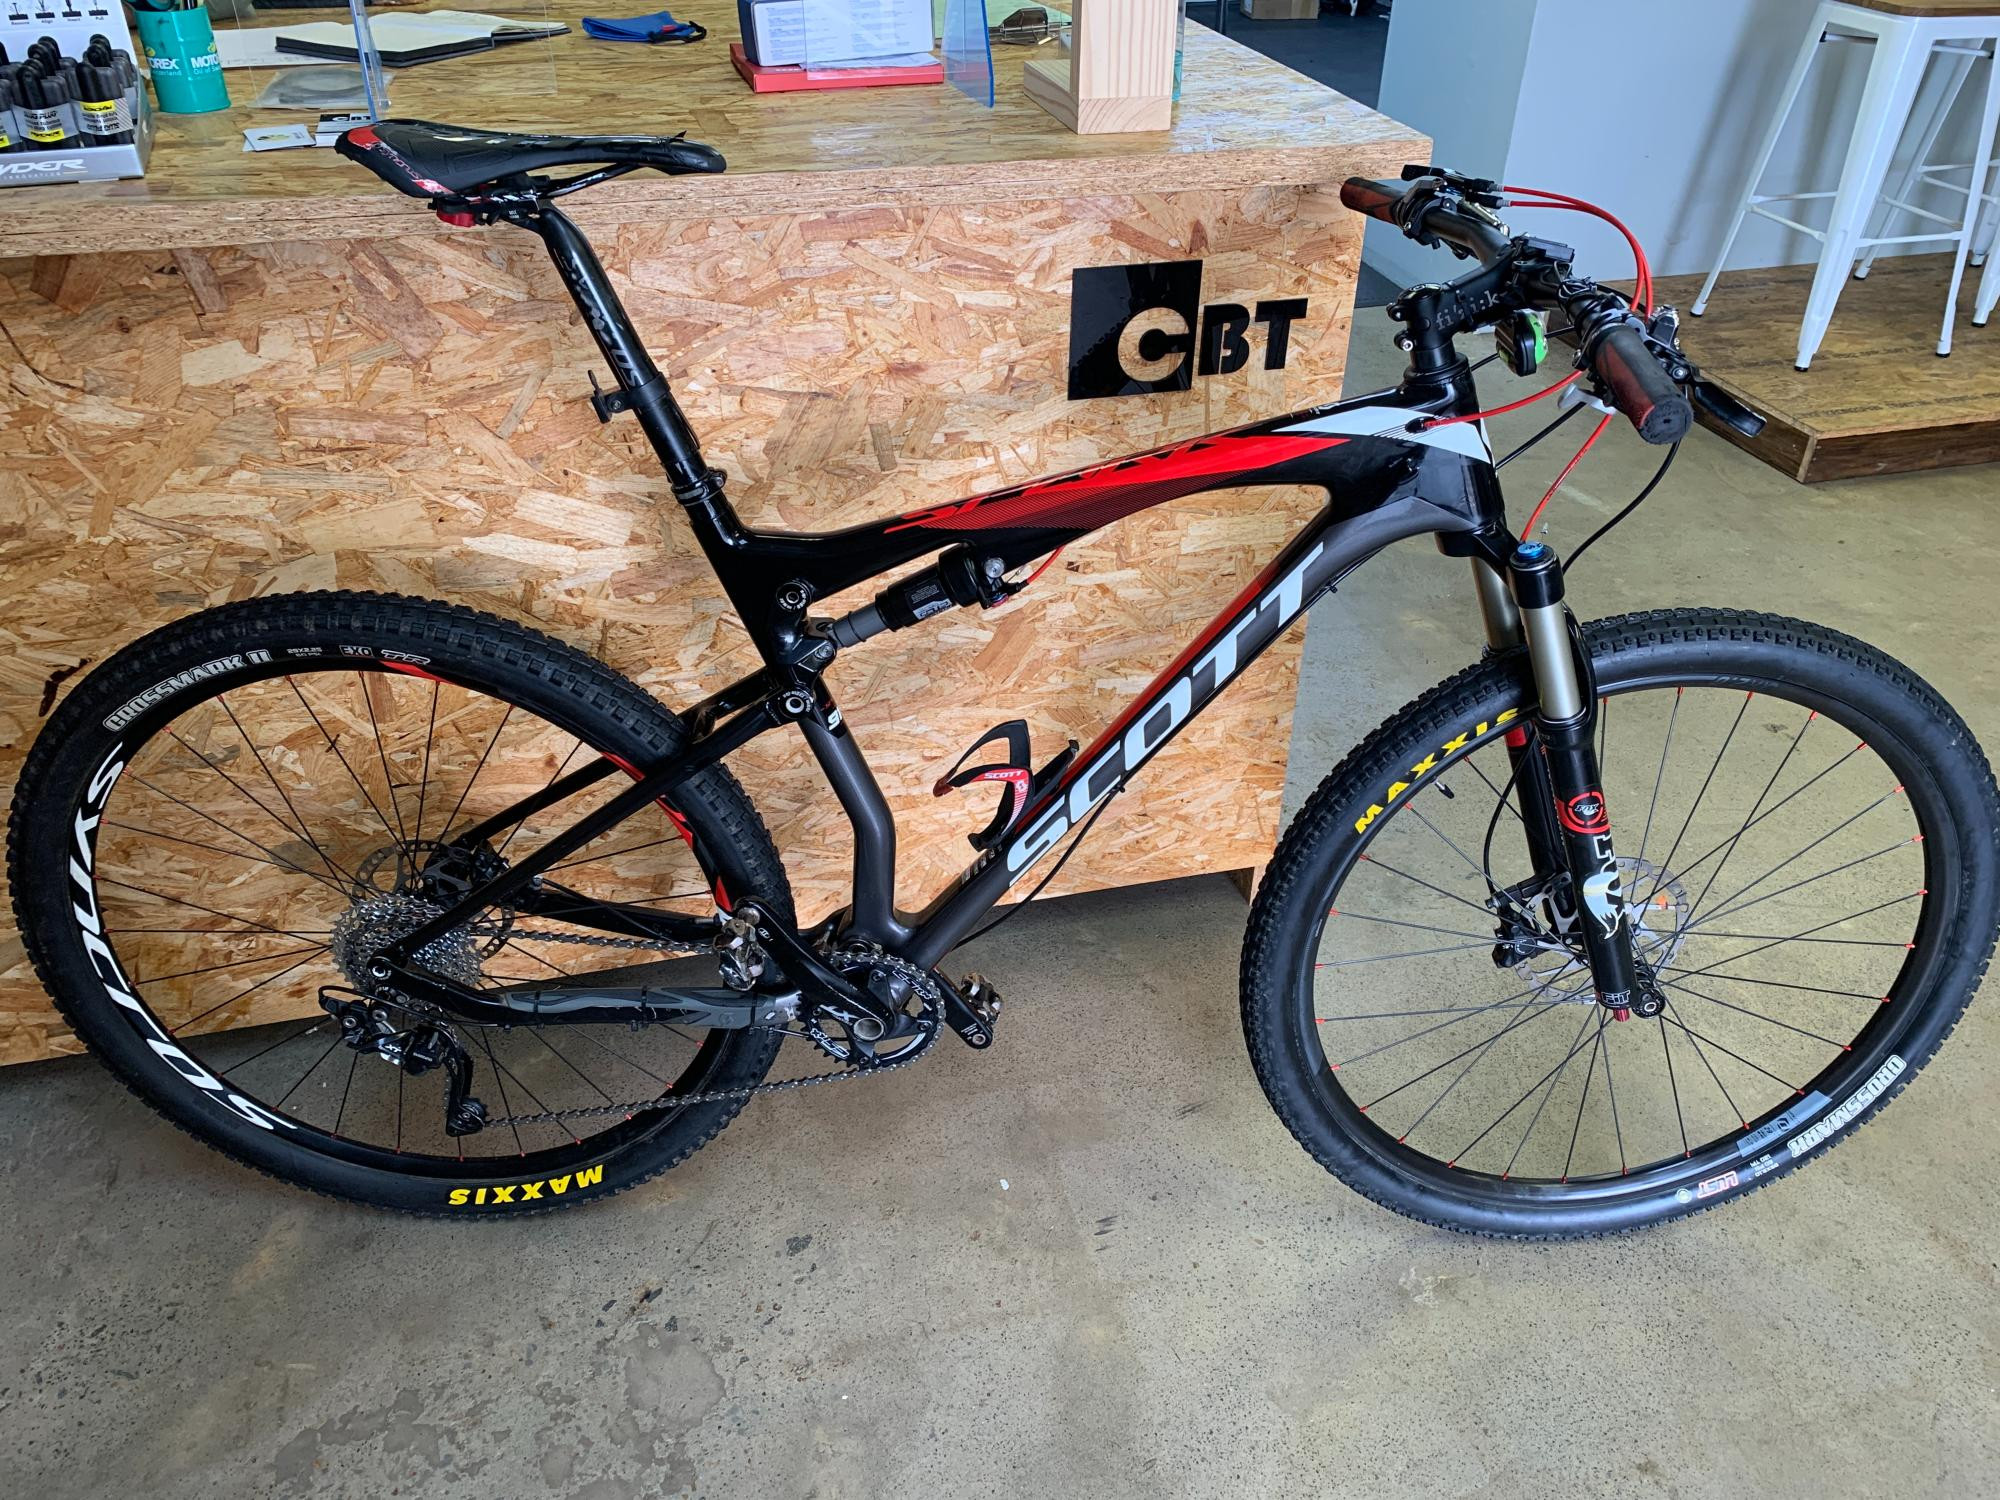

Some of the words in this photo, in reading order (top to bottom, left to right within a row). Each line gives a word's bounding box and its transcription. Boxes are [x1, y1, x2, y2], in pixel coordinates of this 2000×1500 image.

[148, 57, 180, 69] OREX
[191, 54, 220, 69] MOTO
[1117, 298, 1309, 382] CBT
[339, 645, 374, 658] EXO
[381, 649, 431, 665] TR
[103, 655, 247, 731] CROSSMARK
[1007, 542, 1324, 887] SCOTT
[983, 770, 1024, 779] SCOTT
[1354, 708, 1520, 834] MAXXIS
[1787, 1055, 1908, 1157] CROSSMARK
[448, 1164, 604, 1206] MAXXIS
